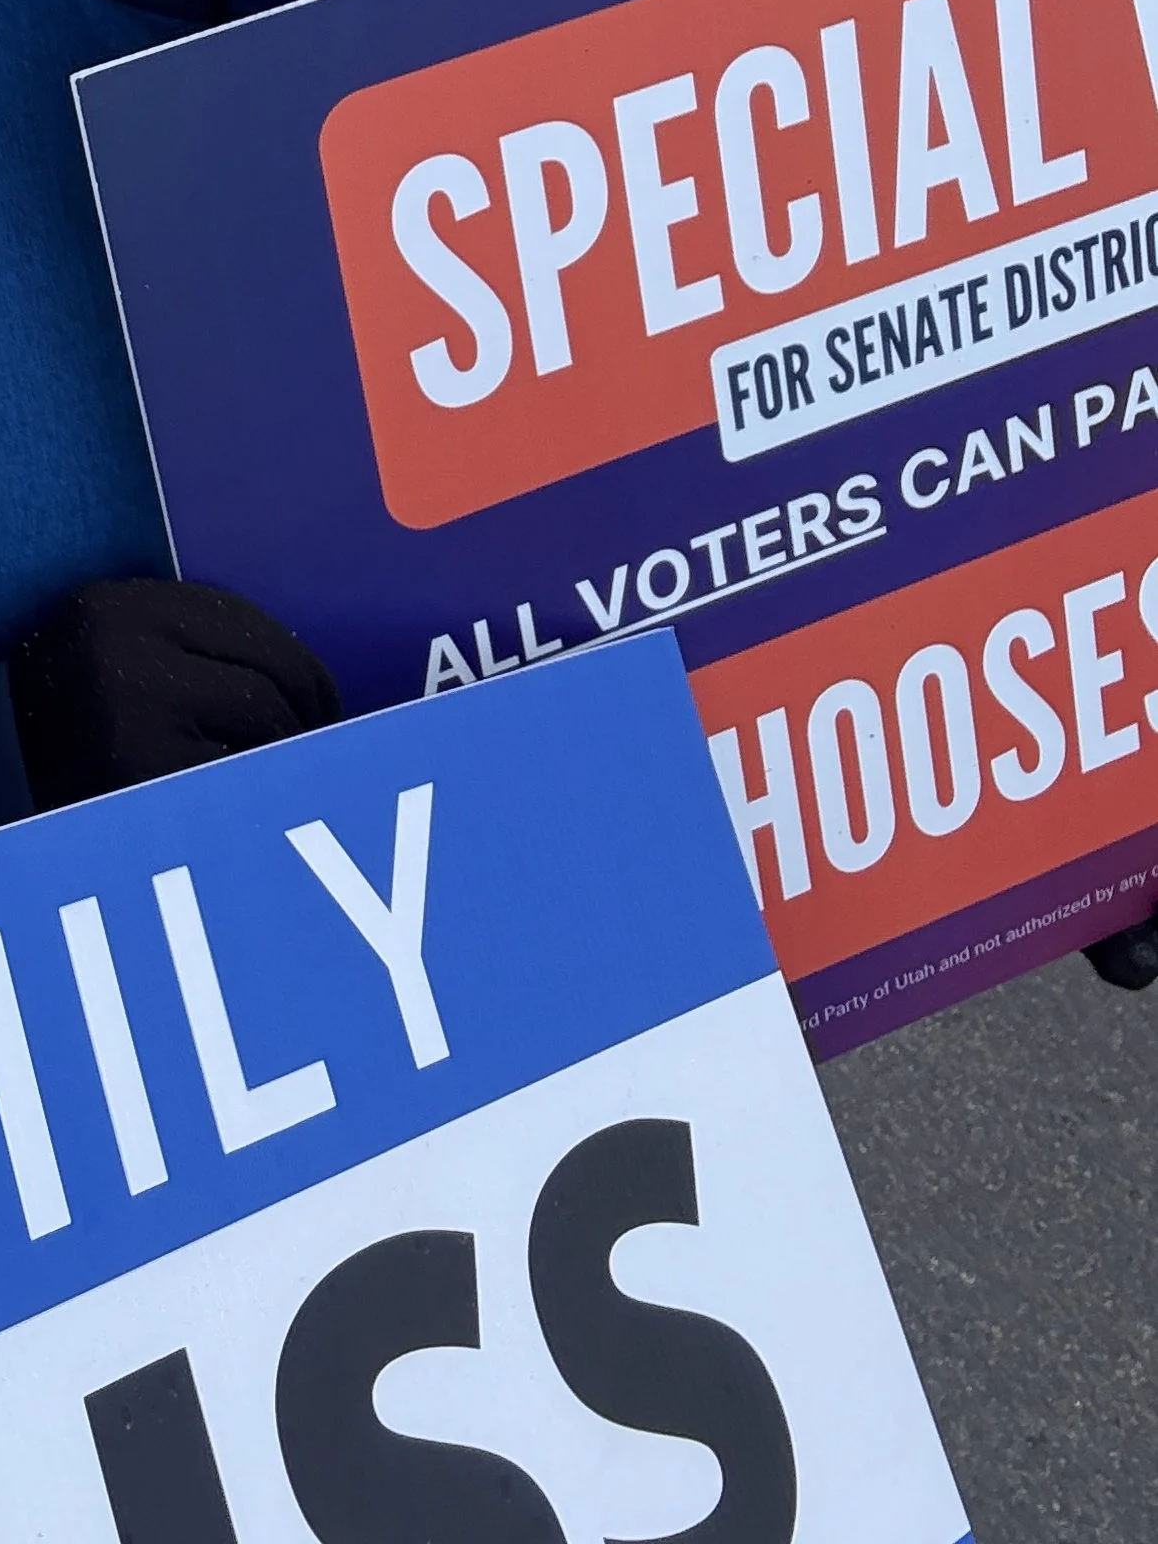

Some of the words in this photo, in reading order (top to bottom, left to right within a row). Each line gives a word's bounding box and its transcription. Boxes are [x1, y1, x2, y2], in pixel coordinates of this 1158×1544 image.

[727, 344, 815, 432] FOR
[826, 274, 993, 394] SENATE
[423, 602, 563, 697] ALL
[576, 474, 879, 631] VOTERS
[900, 405, 1056, 509] CAN
[1073, 366, 1158, 448] PA
[708, 556, 1158, 911] HOOSE
[824, 993, 869, 1023] Party
[873, 981, 891, 1000] of
[894, 964, 935, 990] Utah
[938, 946, 971, 972] and
[974, 934, 1002, 957] not
[1005, 893, 1091, 944] authorized
[1095, 883, 1115, 903] by
[1118, 870, 1148, 893] any
